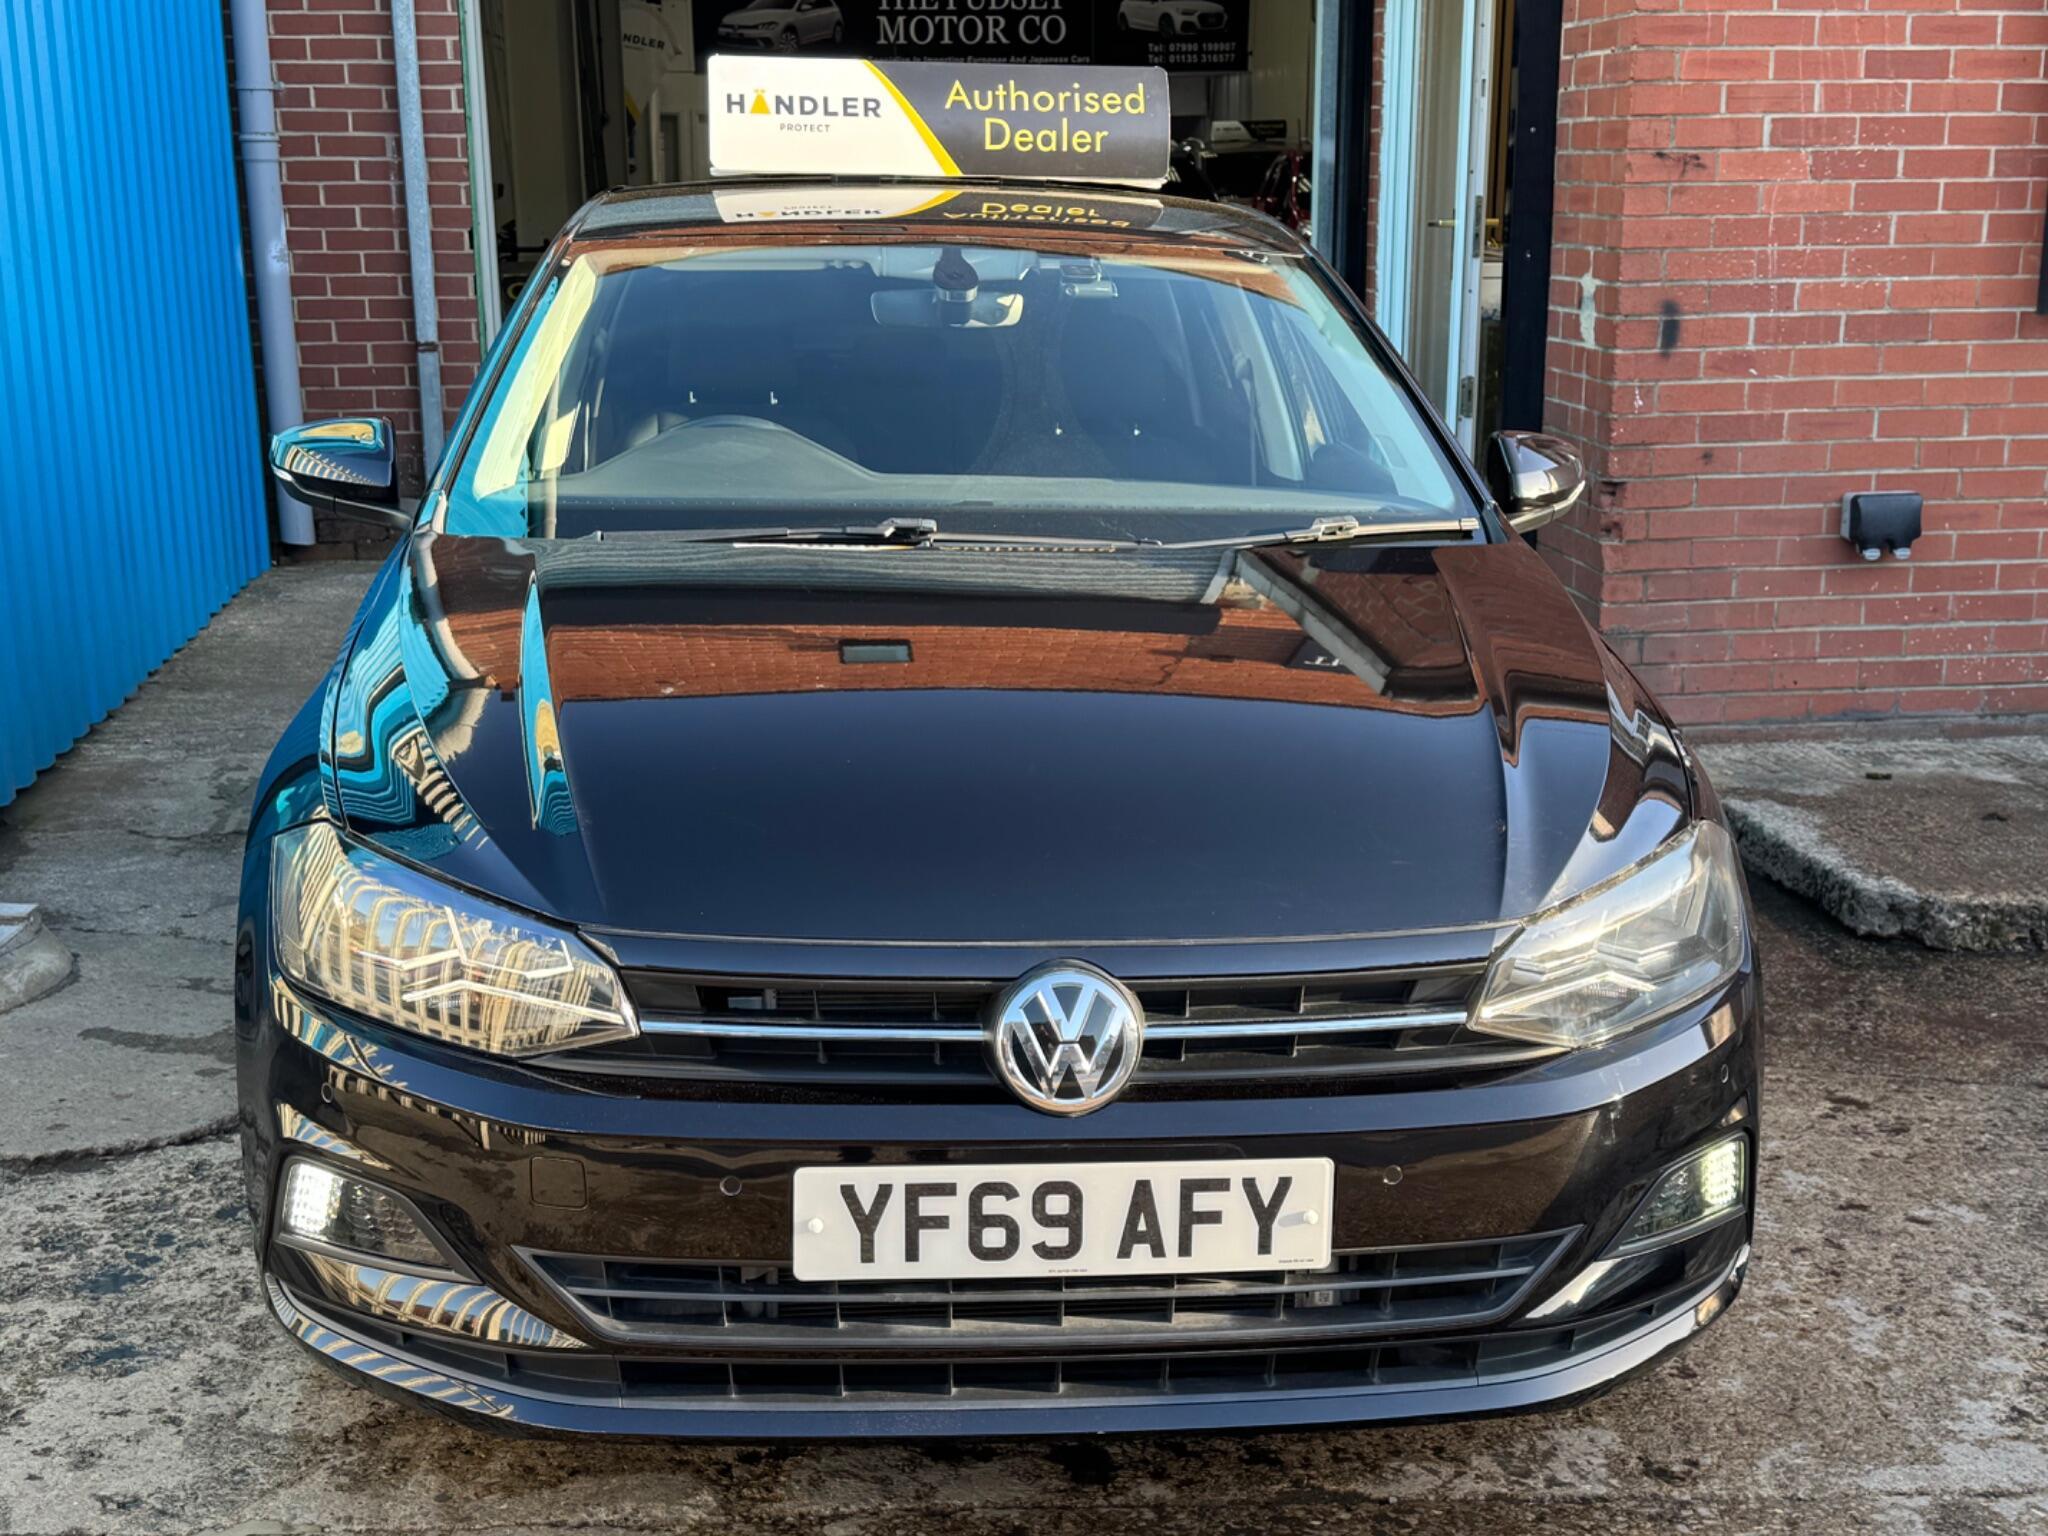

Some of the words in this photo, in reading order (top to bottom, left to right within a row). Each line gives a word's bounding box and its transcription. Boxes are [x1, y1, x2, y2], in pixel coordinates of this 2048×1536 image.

[623, 33, 665, 50] NDLER
[876, 15, 1010, 45] MOTOR
[1018, 15, 1067, 45] CO
[945, 80, 1145, 114] Authorised
[779, 122, 831, 133] PROTECT
[984, 117, 1109, 152] Dealer
[839, 1180, 1083, 1264] YF69
[1116, 1176, 1293, 1259] AFY
